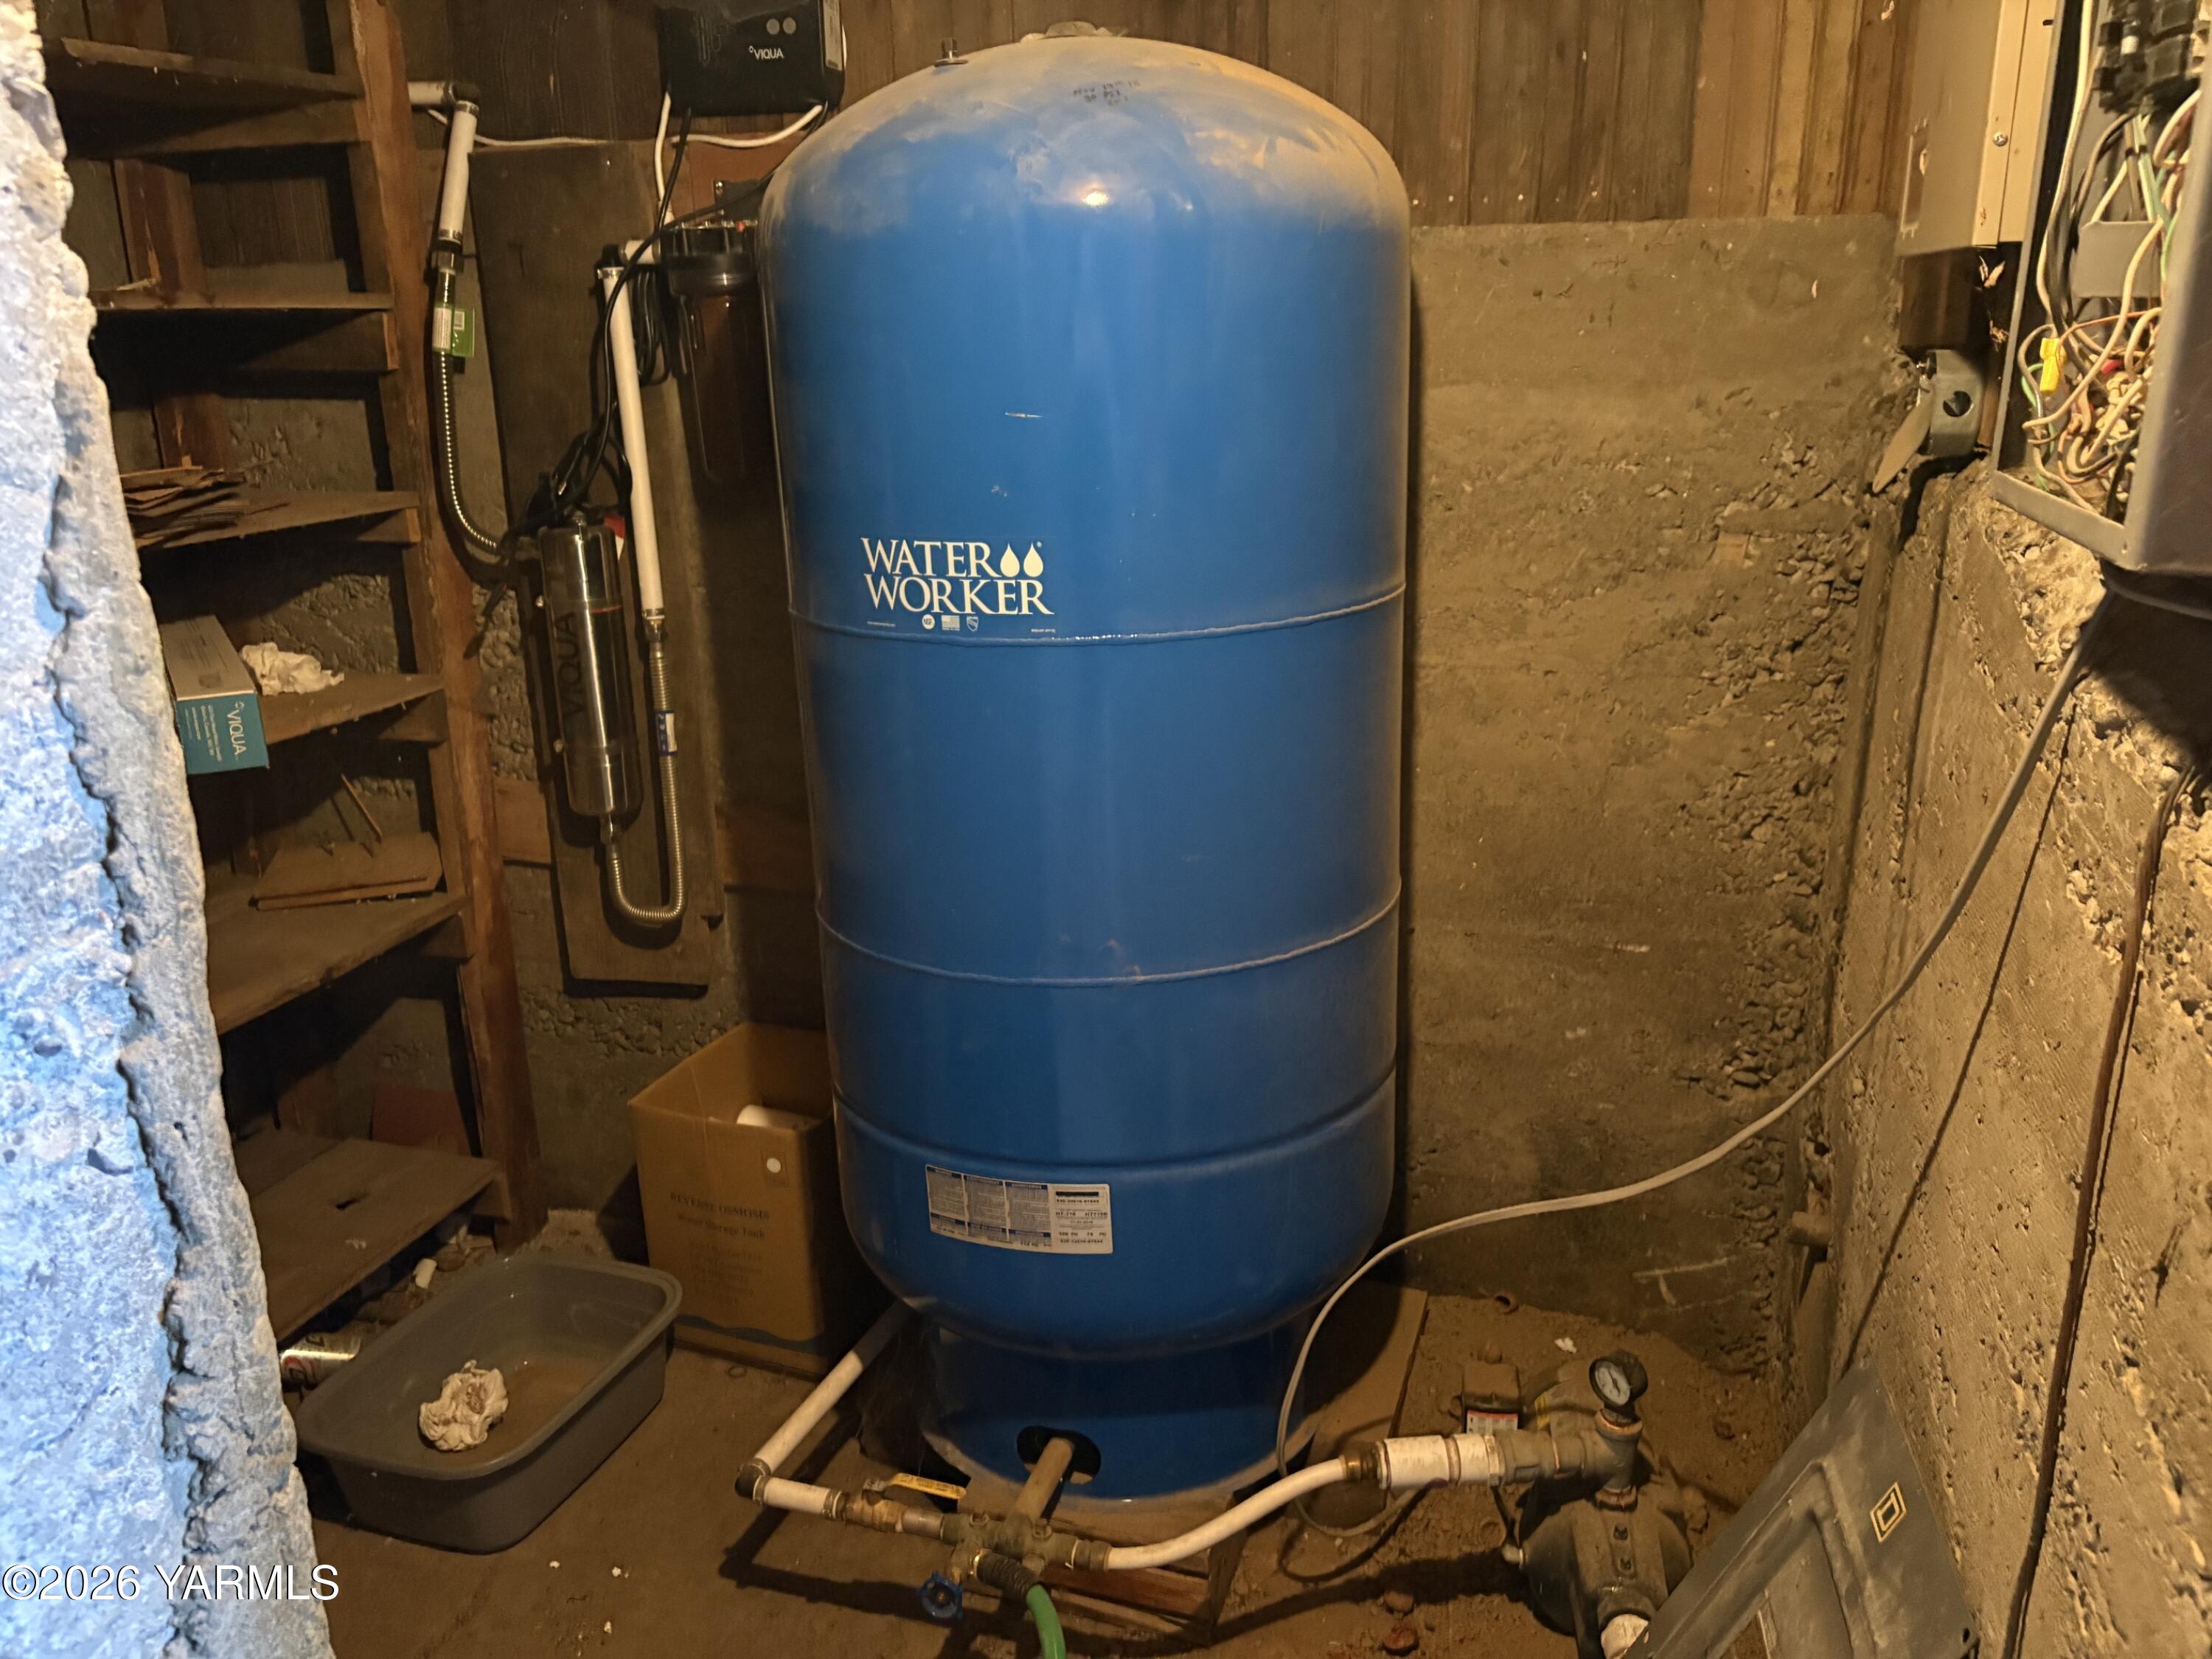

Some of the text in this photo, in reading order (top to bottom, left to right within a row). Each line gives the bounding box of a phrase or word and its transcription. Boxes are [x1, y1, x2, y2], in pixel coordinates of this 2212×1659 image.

[753, 46, 785, 60] VIQUA
[860, 538, 1002, 577] WATER
[863, 573, 1054, 615] WORKER
[554, 613, 585, 717] VIQUA
[227, 709, 247, 755] VIQUA
